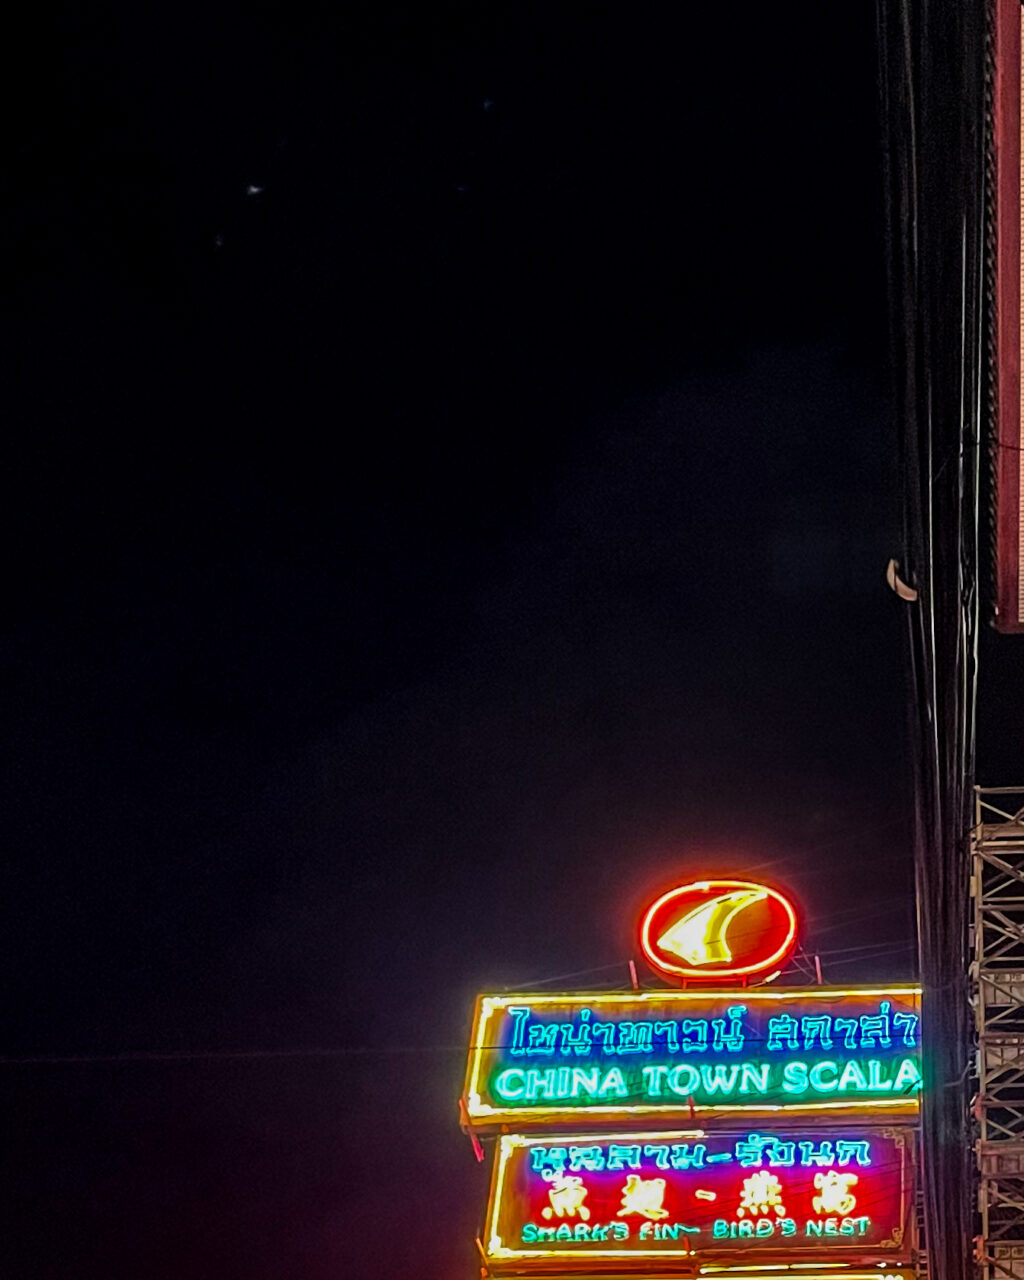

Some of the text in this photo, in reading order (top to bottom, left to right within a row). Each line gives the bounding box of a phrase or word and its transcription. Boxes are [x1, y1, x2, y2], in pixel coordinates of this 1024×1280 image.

[508, 1001, 920, 1057] ไชน่าทาวน์ สกาล่า
[496, 1059, 922, 1099] CHINA TOWN SCALA
[521, 1221, 630, 1244] SHARK'S
[712, 1217, 797, 1240] BIRD'S
[805, 1215, 872, 1238] NEST
